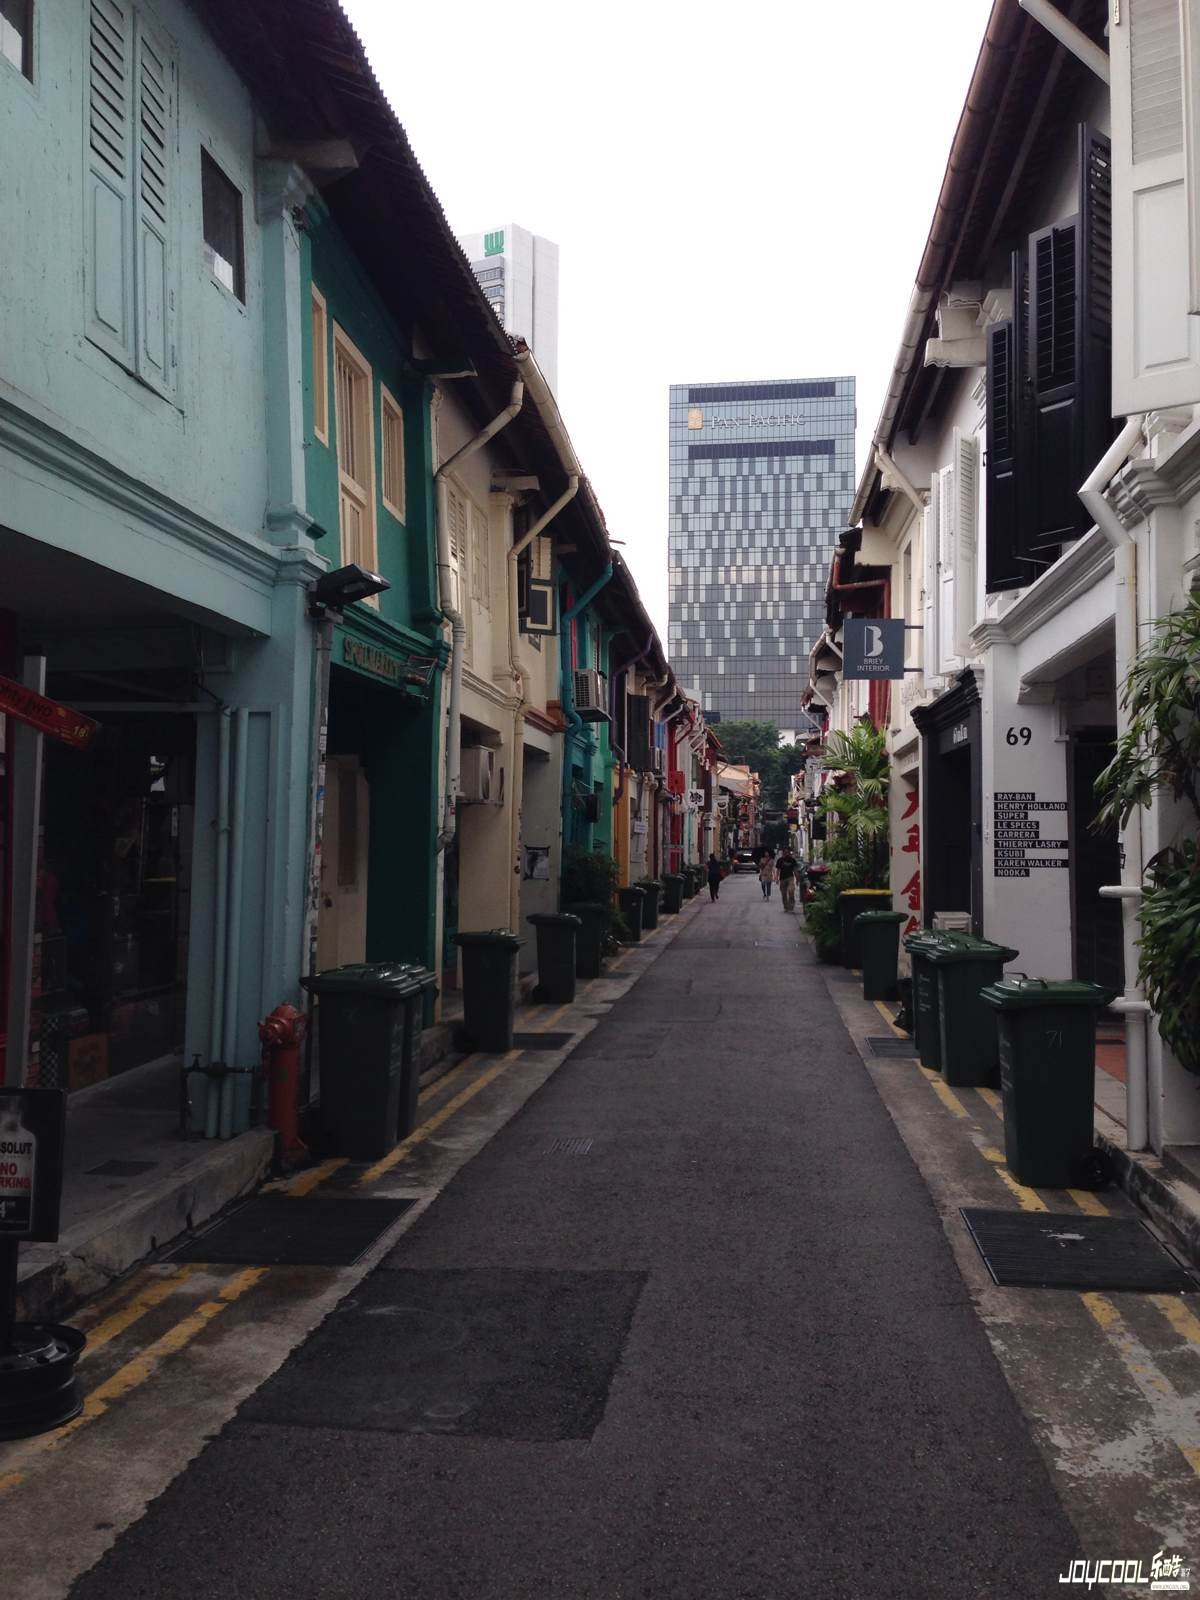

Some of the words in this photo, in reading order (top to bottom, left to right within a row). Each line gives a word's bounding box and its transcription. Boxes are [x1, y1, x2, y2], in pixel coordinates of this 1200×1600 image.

[711, 416, 741, 429] PAN
[748, 414, 806, 428] PACIFIC
[856, 664, 890, 672] INTERIOR
[1006, 726, 1032, 746] 69
[997, 793, 1033, 801] RAY-BAN
[998, 821, 1009, 829] LE
[1010, 821, 1037, 829] SPECS
[0, 1142, 33, 1154] SOLUT
[0, 1163, 17, 1175] NO
